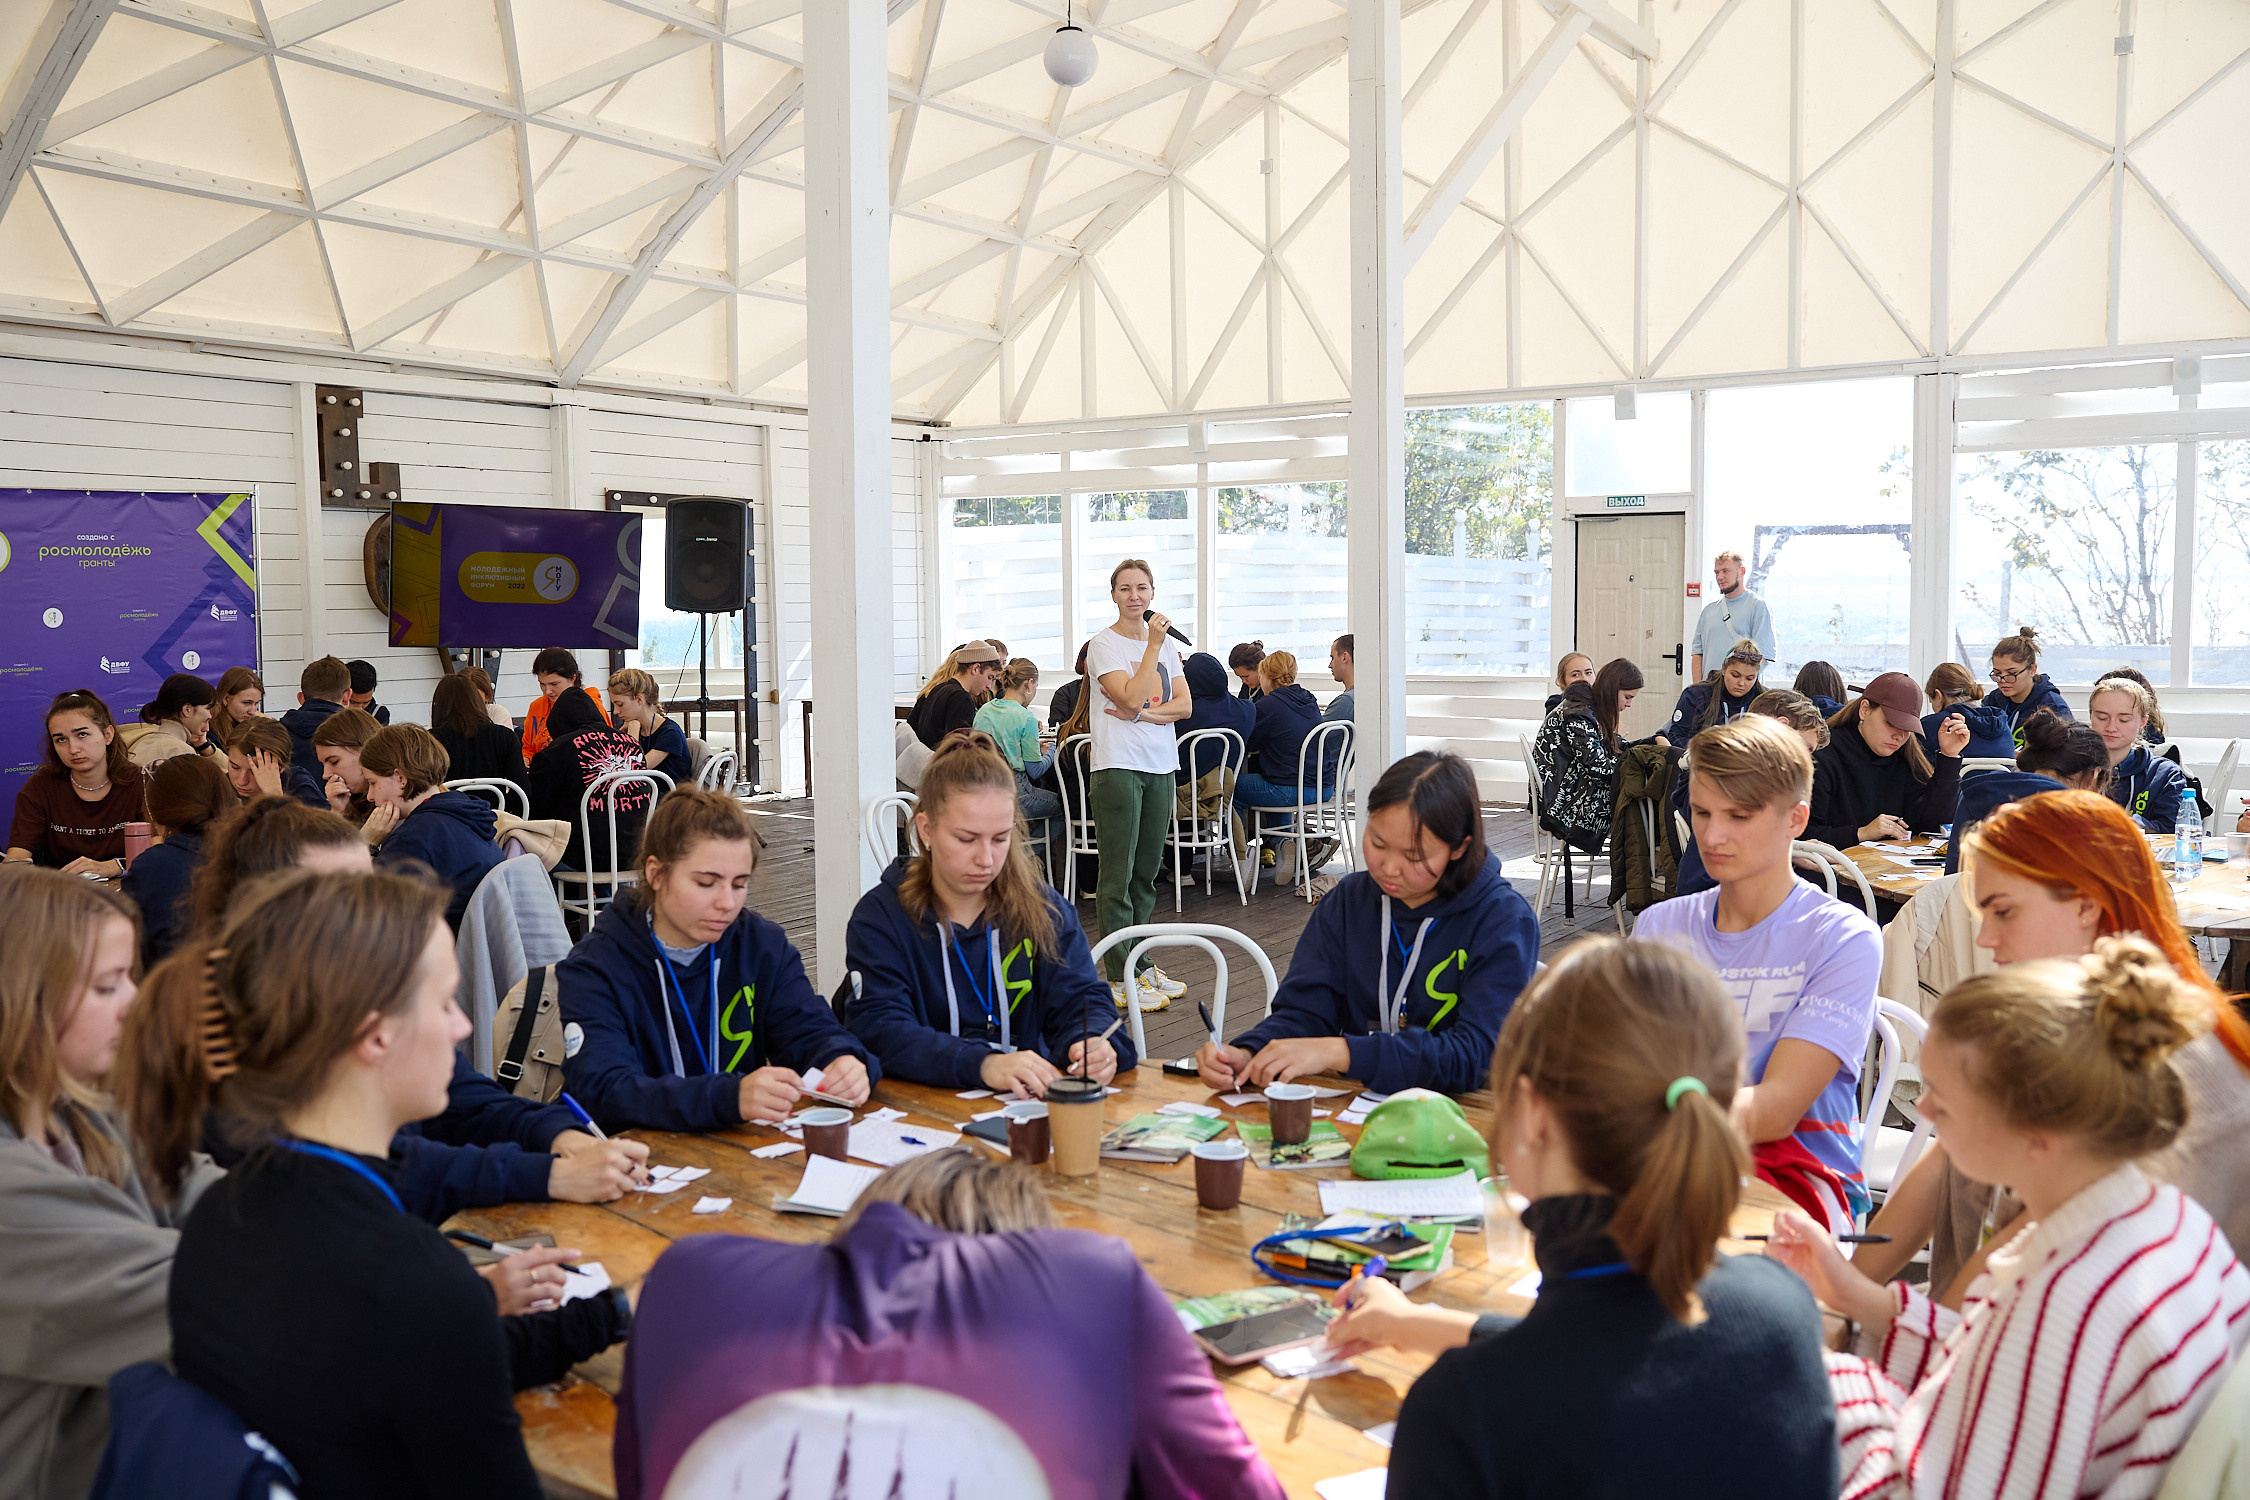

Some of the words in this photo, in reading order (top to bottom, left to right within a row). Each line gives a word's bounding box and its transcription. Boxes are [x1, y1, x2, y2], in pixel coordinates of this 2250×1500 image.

[1608, 496, 1645, 507] ВЫХОД
[39, 543, 152, 562] росмолодёжь
[78, 560, 116, 570] гранты
[507, 582, 526, 590] 2022
[110, 660, 130, 669] ДВФУ
[573, 731, 609, 749] RICK
[76, 828, 97, 836] TICKET
[98, 827, 107, 835] TO
[1711, 965, 1770, 980] OSTOK
